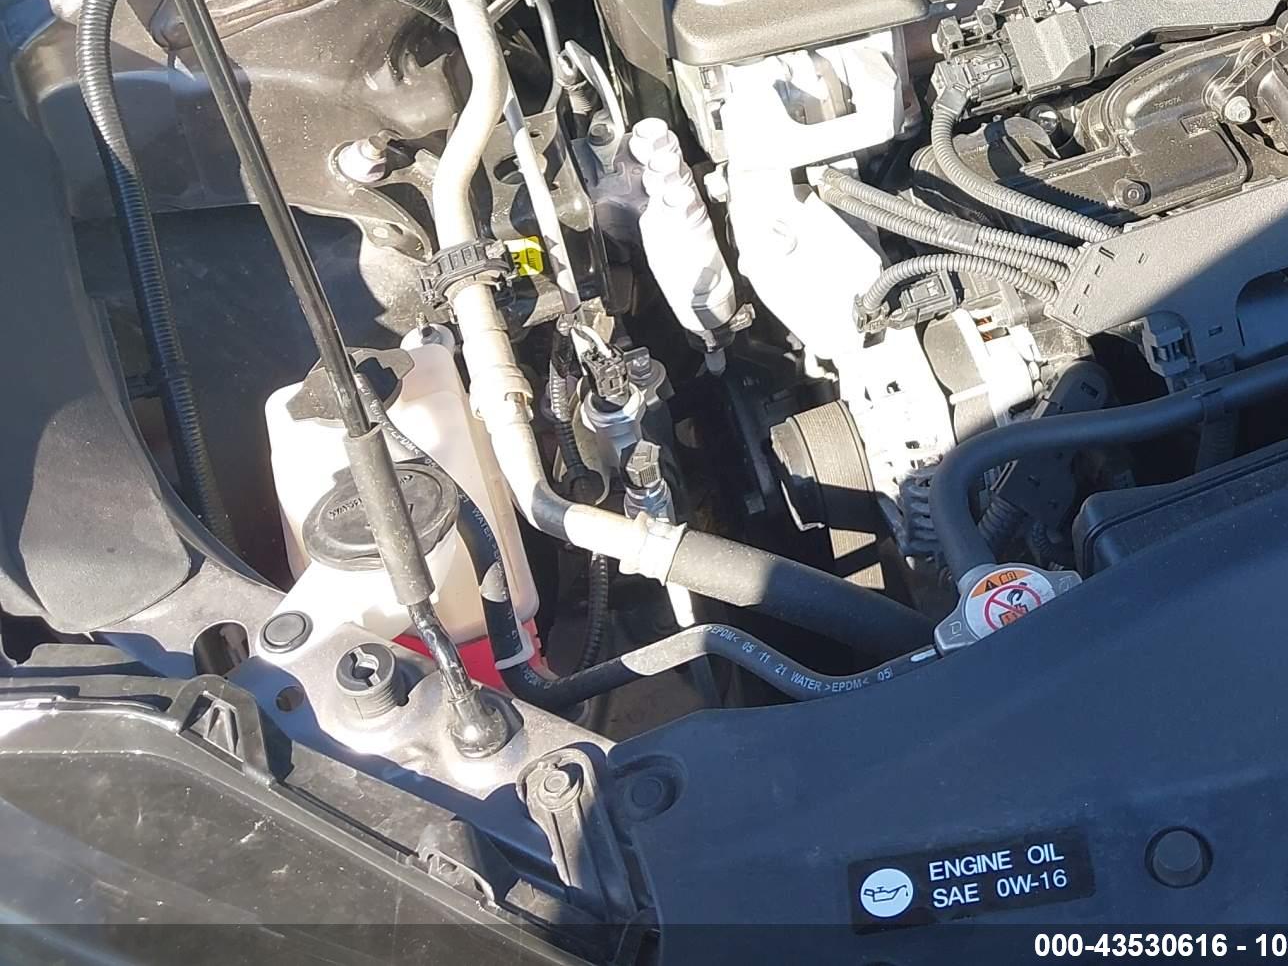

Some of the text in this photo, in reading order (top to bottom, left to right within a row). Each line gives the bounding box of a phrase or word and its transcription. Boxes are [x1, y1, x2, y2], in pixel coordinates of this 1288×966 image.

[472, 507, 493, 542] WATER
[790, 671, 822, 692] WATER
[929, 843, 1064, 882] ENGINE OIL
[933, 869, 1067, 908] SAE 0W-16
